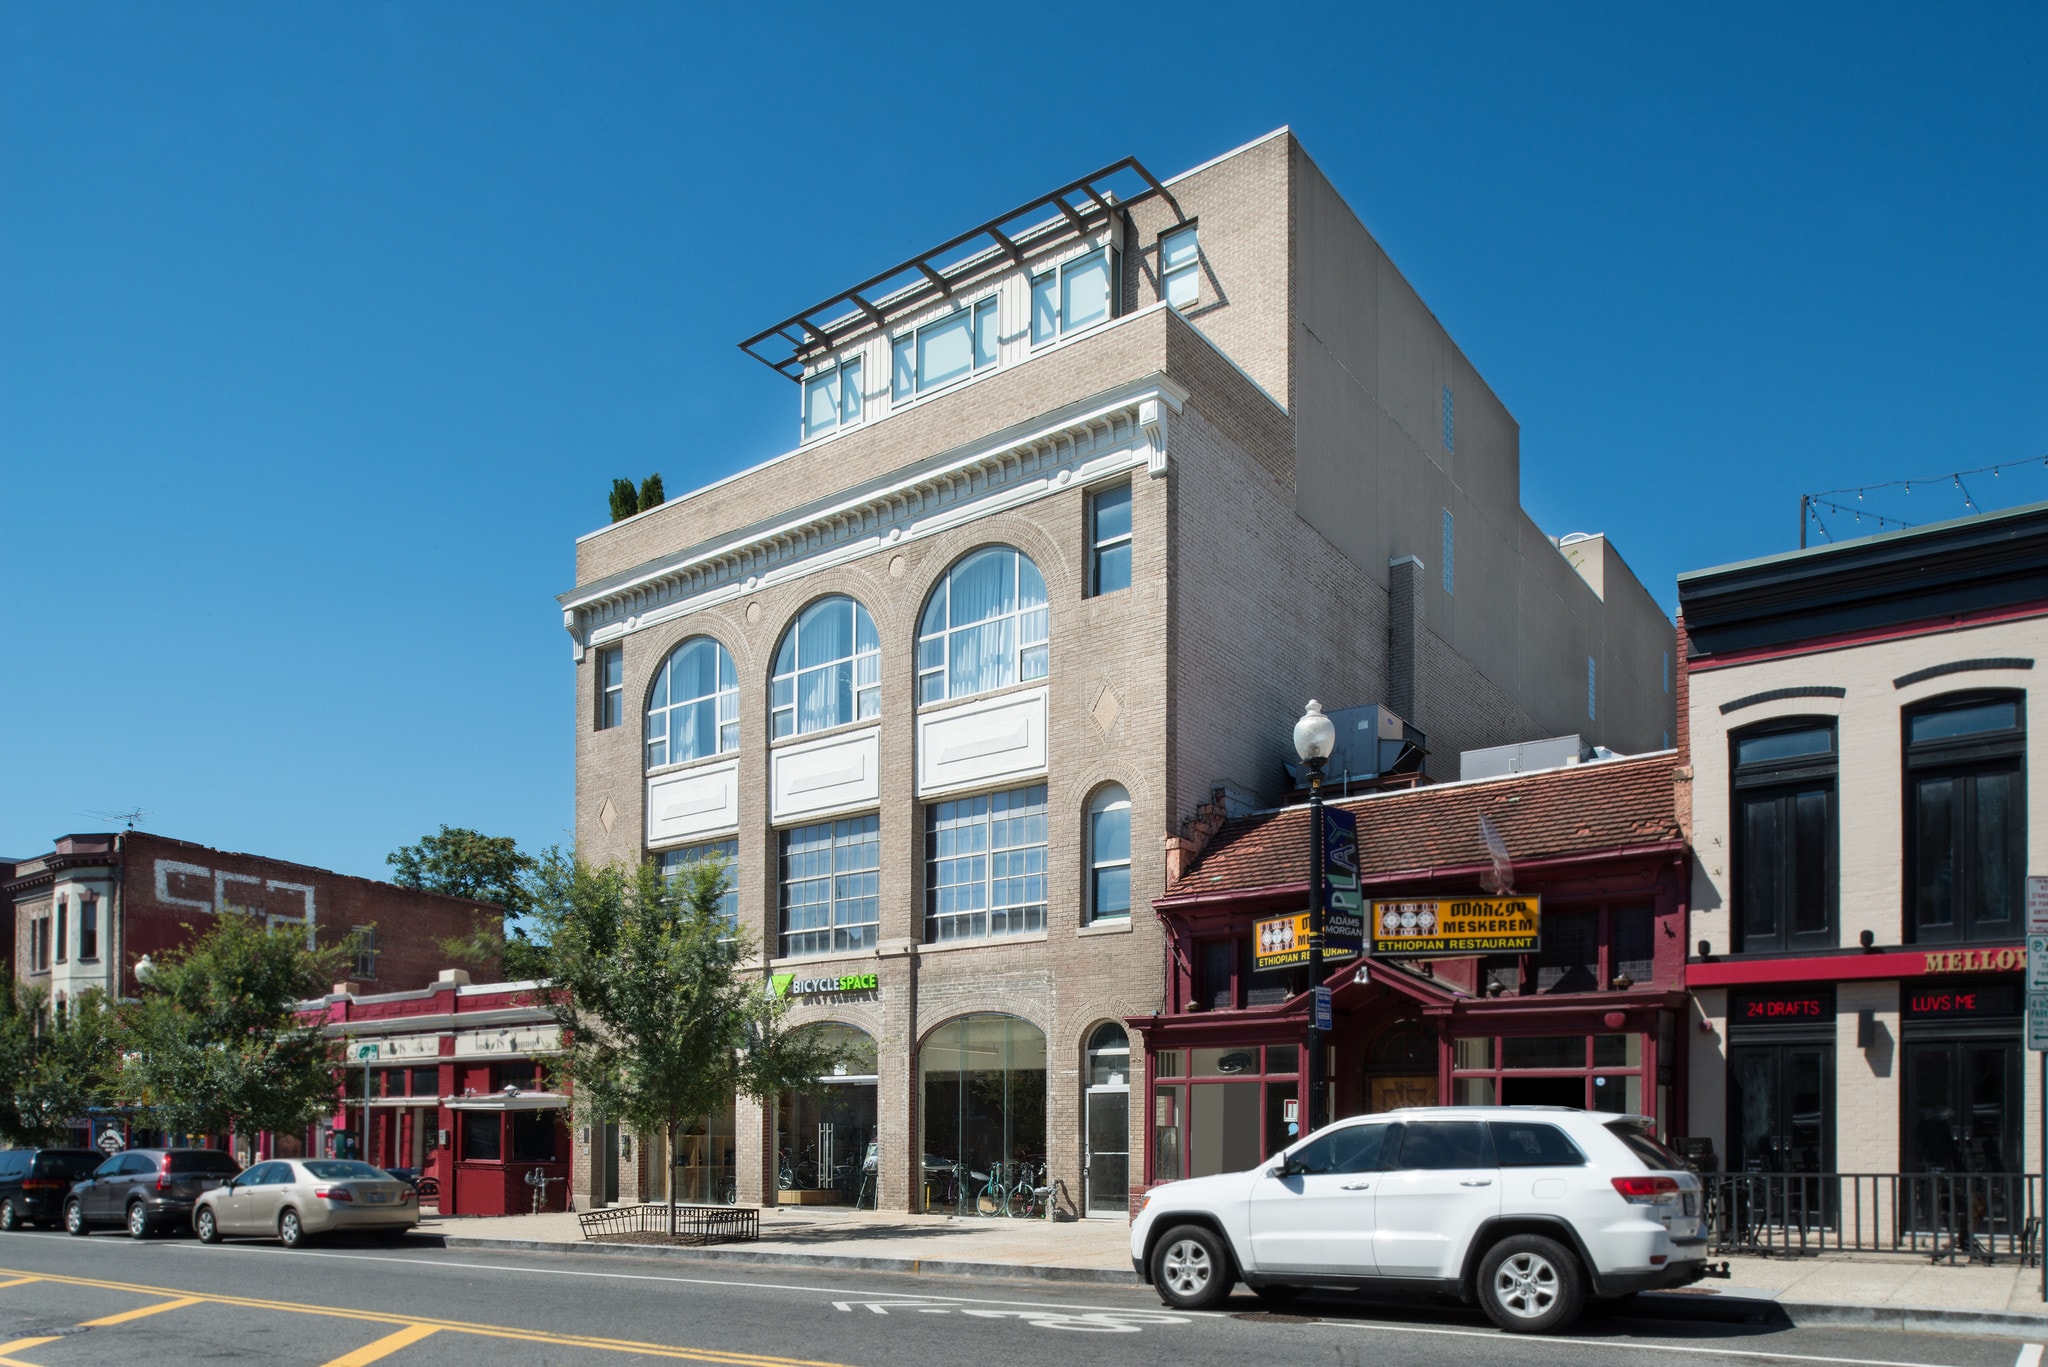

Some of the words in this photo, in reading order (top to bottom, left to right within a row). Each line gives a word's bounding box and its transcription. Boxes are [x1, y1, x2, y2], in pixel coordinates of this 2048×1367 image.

[1327, 815, 1359, 910] PLAY
[1329, 915, 1360, 927] ADAMS
[1443, 918, 1533, 934] MESKEREM
[1325, 925, 1362, 937] MORGAN
[1378, 940, 1444, 951] ETHIOPIAN
[1450, 937, 1533, 949] RESTAURANT
[1259, 952, 1299, 967] ETHIOPIAN
[793, 973, 877, 994] BICYCLESPACE
[1747, 1002, 1763, 1017] 24
[1767, 1000, 1820, 1017] DRAFTS
[1912, 995, 1951, 1012] LUVS
[1955, 993, 1977, 1010] ME
[346, 1138, 354, 1148] P
